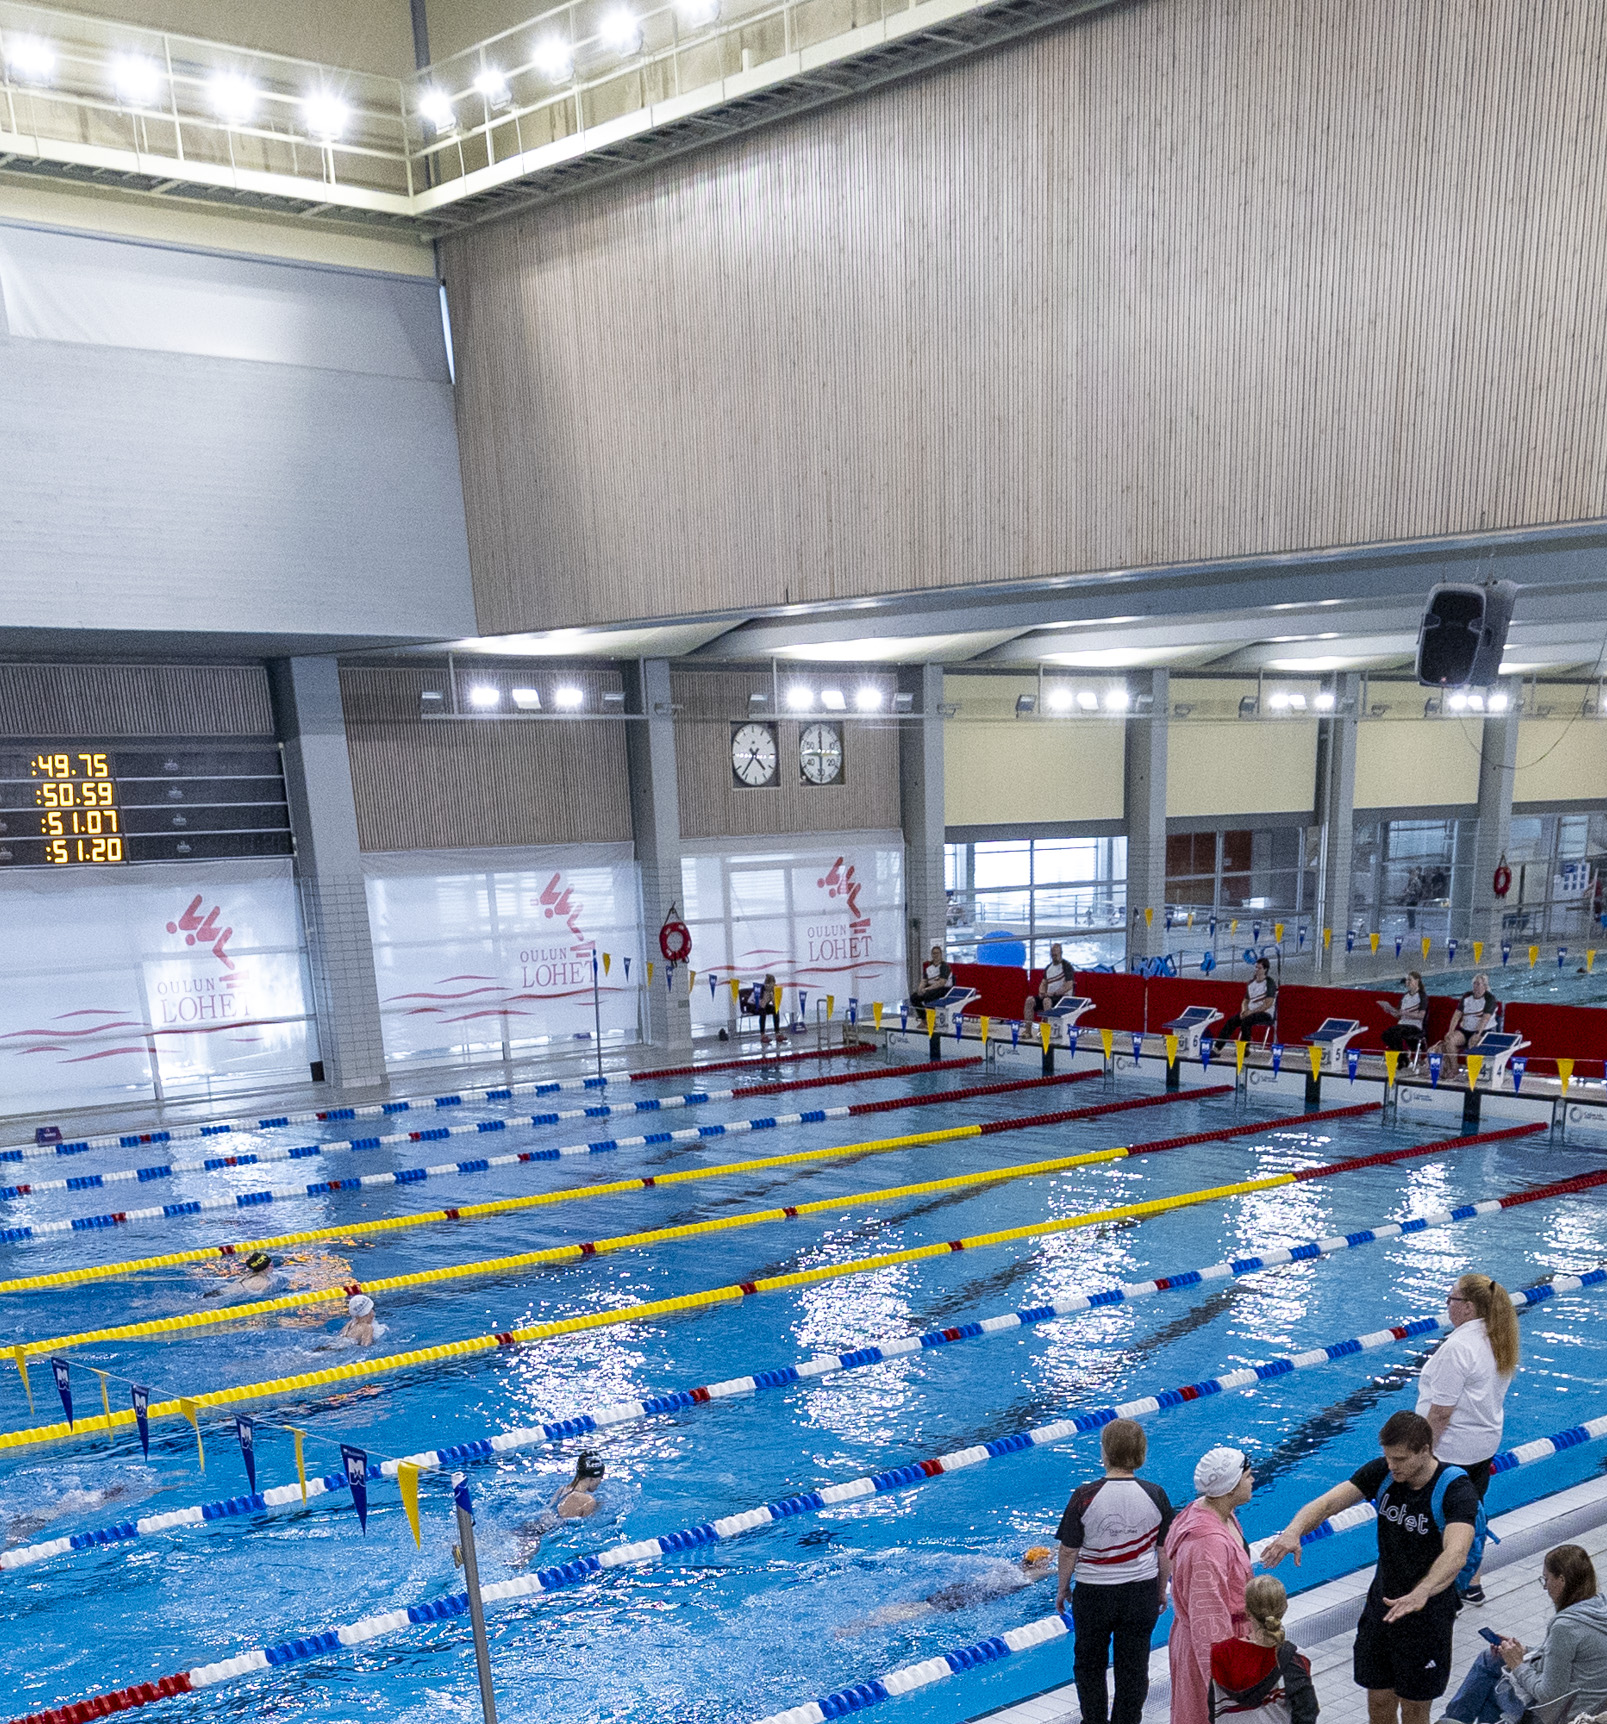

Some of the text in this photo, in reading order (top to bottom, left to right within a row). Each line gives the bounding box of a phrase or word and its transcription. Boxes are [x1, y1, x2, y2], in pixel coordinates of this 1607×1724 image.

[807, 924, 847, 938] OULUN
[519, 947, 567, 963] OULUN
[808, 935, 873, 962] LOHET
[520, 960, 596, 988] LOHET
[157, 977, 215, 995] OULUN
[1192, 1034, 1199, 1047] 6
[1335, 1047, 1341, 1061] 5
[1496, 1063, 1503, 1077] 4
[1378, 1493, 1429, 1535] Lohet
